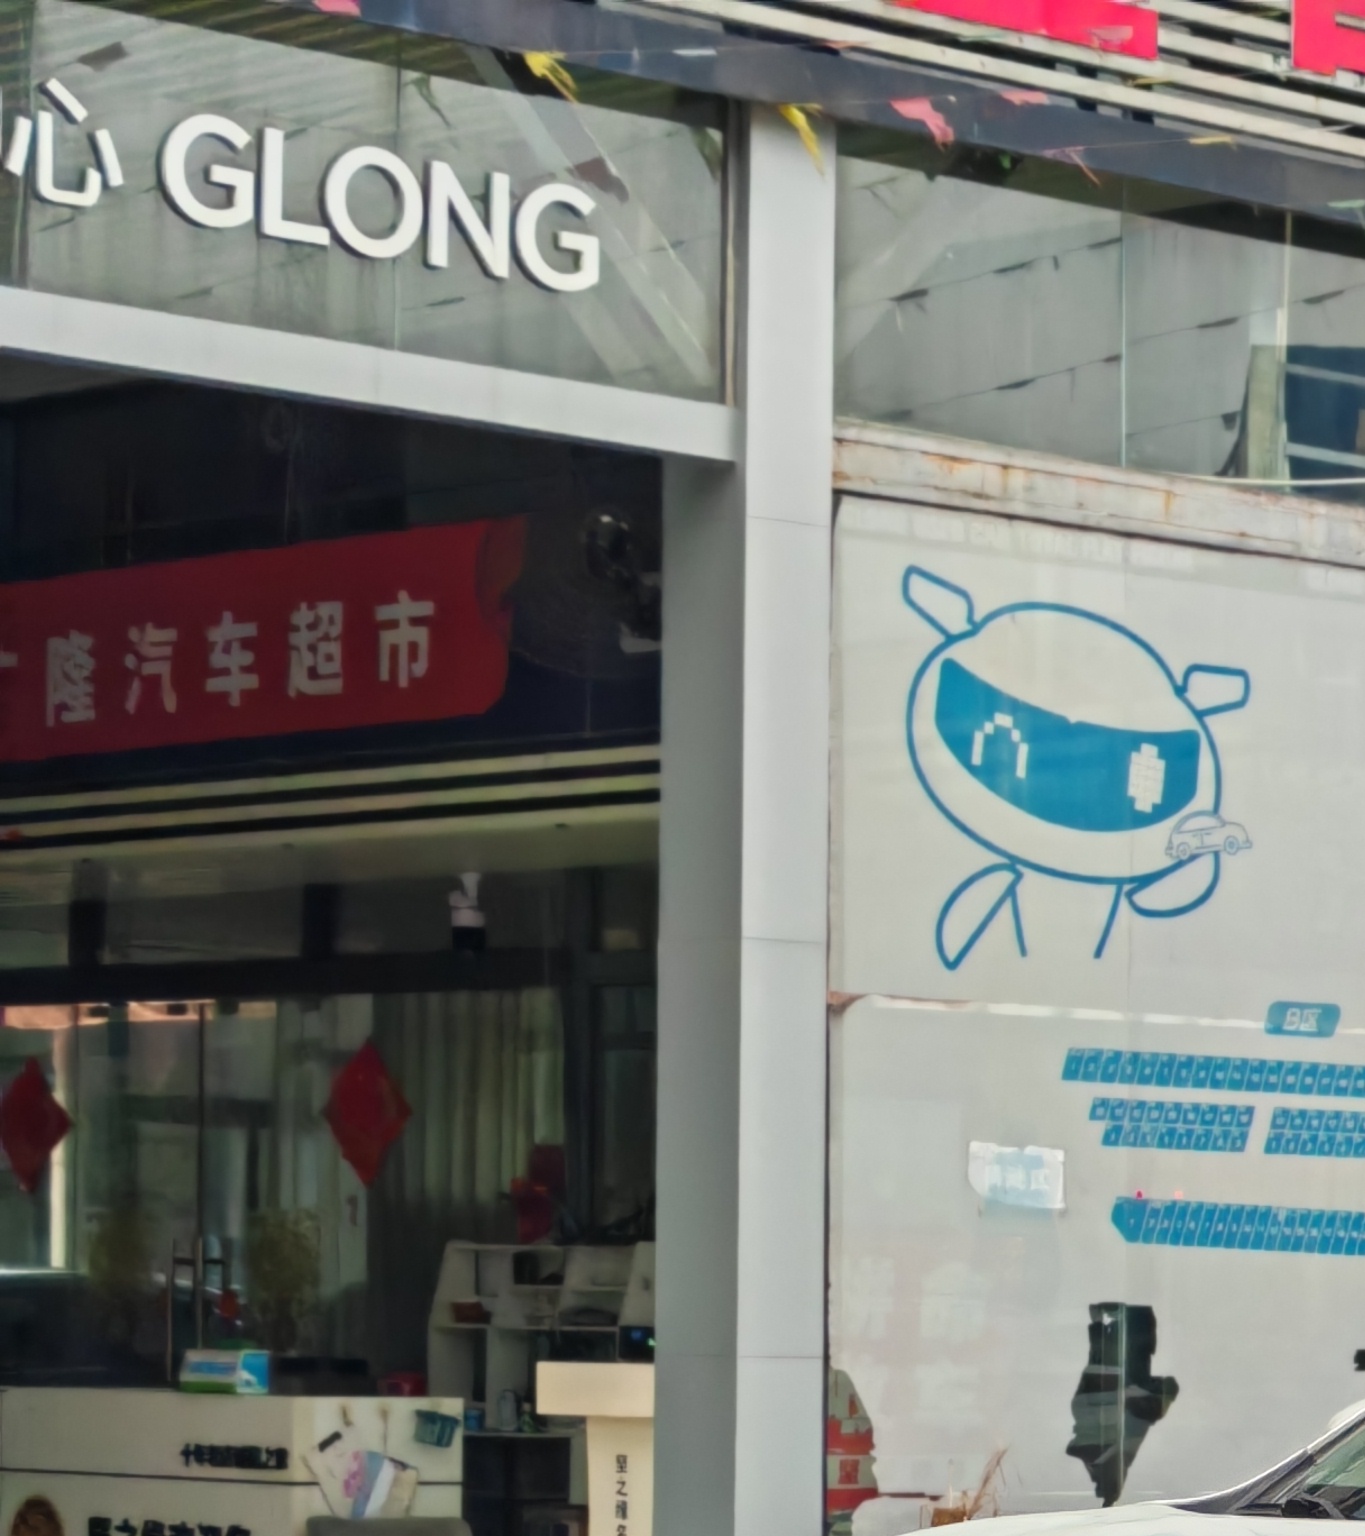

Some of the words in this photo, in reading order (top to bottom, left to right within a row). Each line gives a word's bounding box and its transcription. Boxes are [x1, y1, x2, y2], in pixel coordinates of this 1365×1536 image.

[161, 113, 601, 292] GLONG
[0, 590, 435, 727] 隆汽车超市
